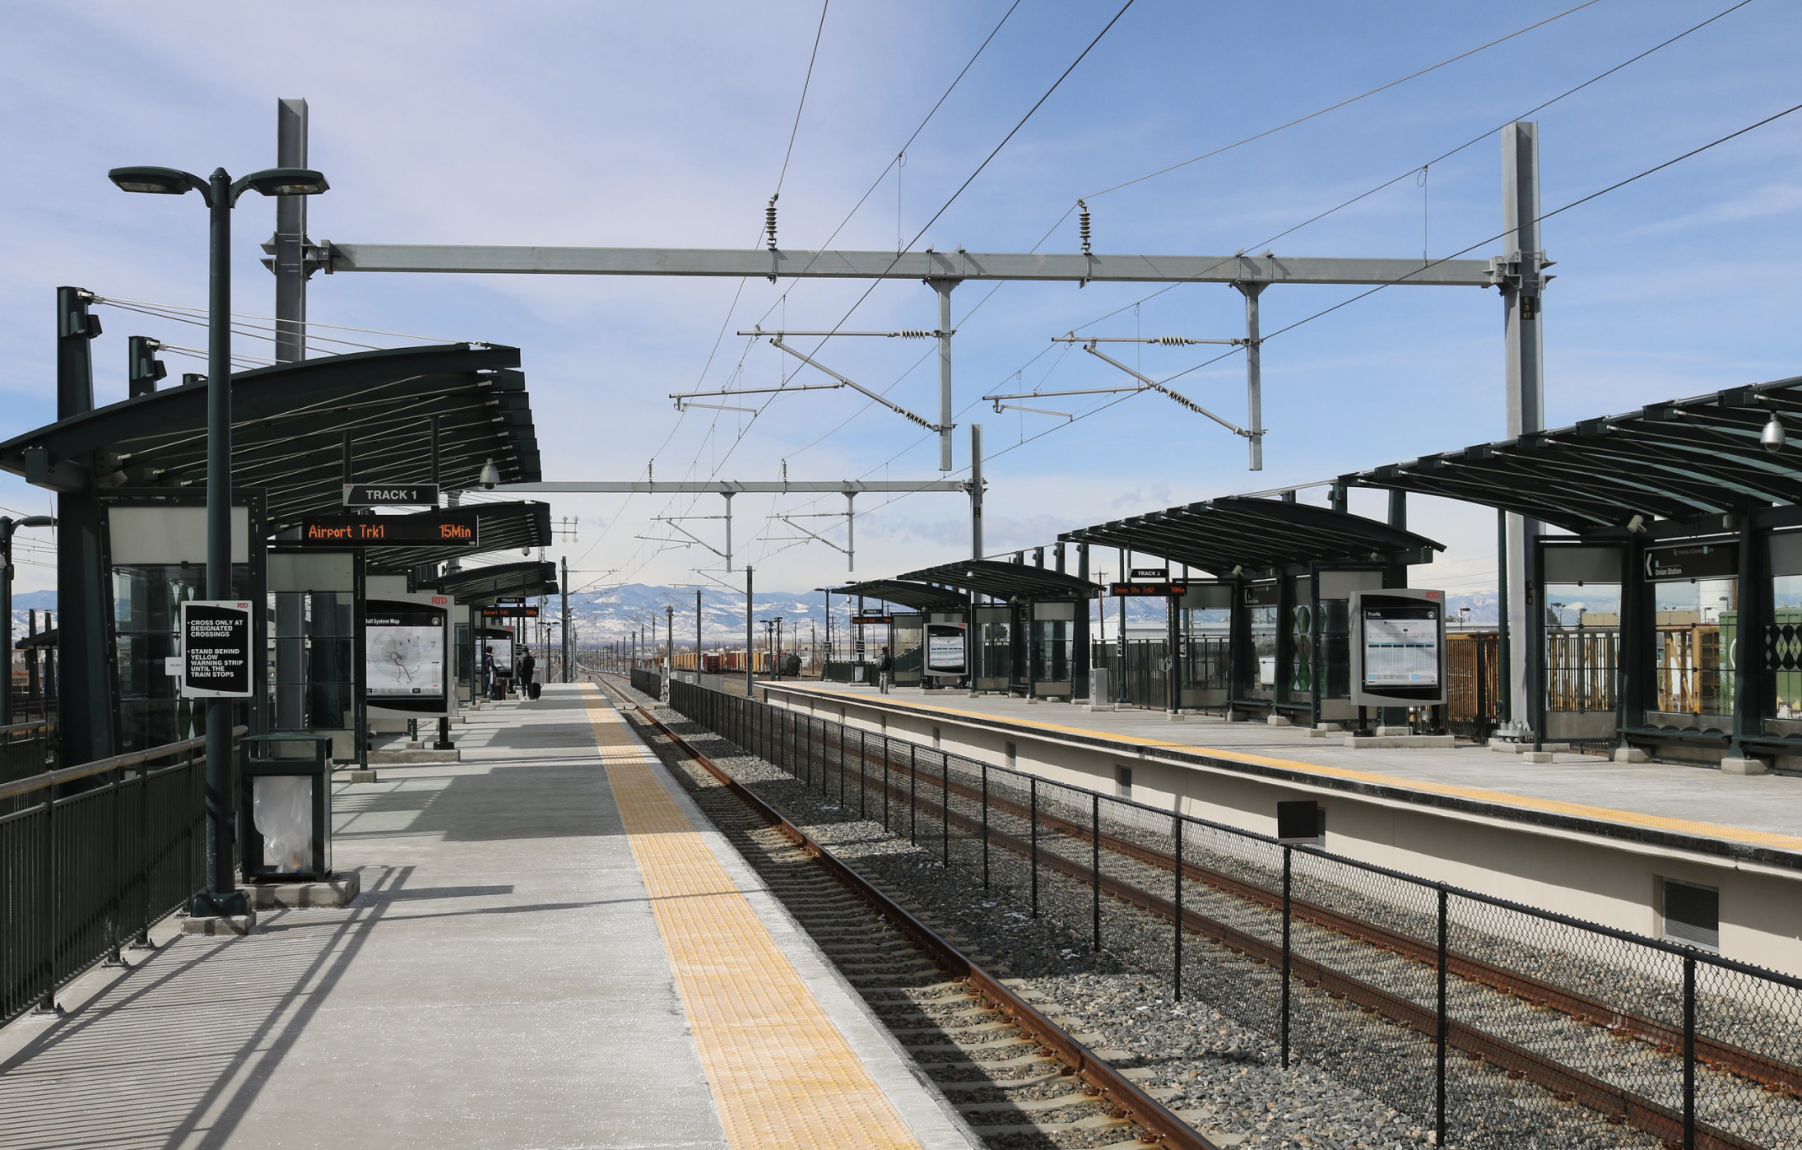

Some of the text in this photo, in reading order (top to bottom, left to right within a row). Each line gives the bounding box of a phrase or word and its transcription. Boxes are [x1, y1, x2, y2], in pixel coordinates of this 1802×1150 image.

[366, 490, 417, 500] TRACK 1
[308, 524, 471, 538] Airport Trk1 15Min
[1655, 567, 1682, 576] Union Station
[431, 596, 448, 604] RTD
